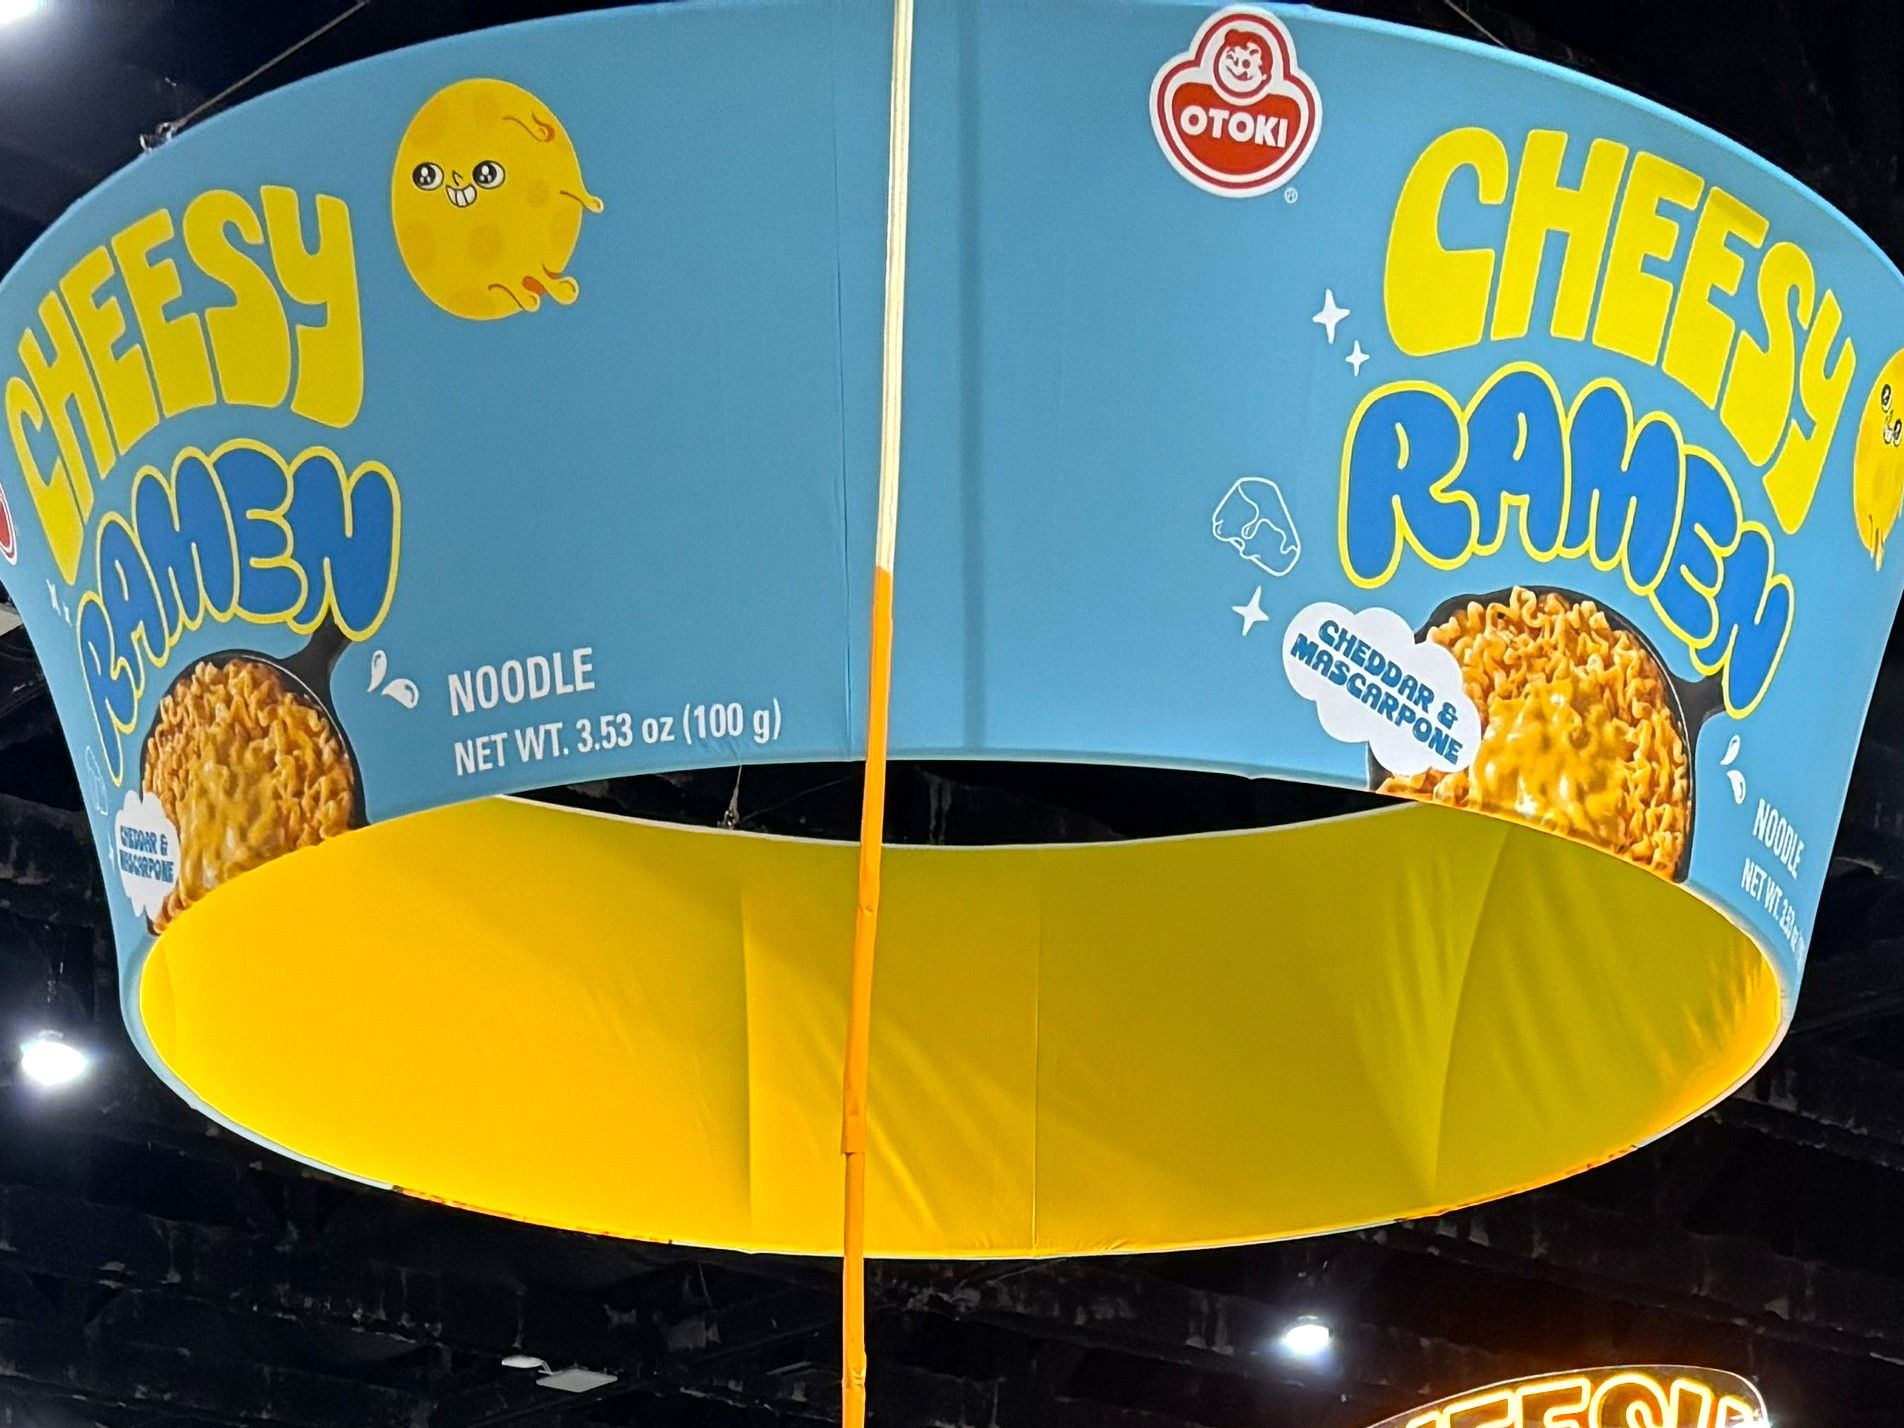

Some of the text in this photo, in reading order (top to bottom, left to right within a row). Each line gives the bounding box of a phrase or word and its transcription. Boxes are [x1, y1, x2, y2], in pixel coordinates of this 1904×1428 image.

[1180, 105, 1289, 148] OTOKI
[4, 185, 366, 586] CHEESY
[1382, 127, 1856, 534] CHEESY
[1338, 361, 1796, 721] RAMEN
[79, 438, 402, 788] RAMEN
[448, 647, 595, 717] NOODLE
[1290, 633, 1463, 765] MASCARPONE
[1318, 619, 1459, 730] CHEDDAR &
[454, 698, 782, 776] NET WT. 3.53 oz (100 g)
[1741, 858, 1768, 902] NET
[1752, 798, 1805, 880] NOODLE
